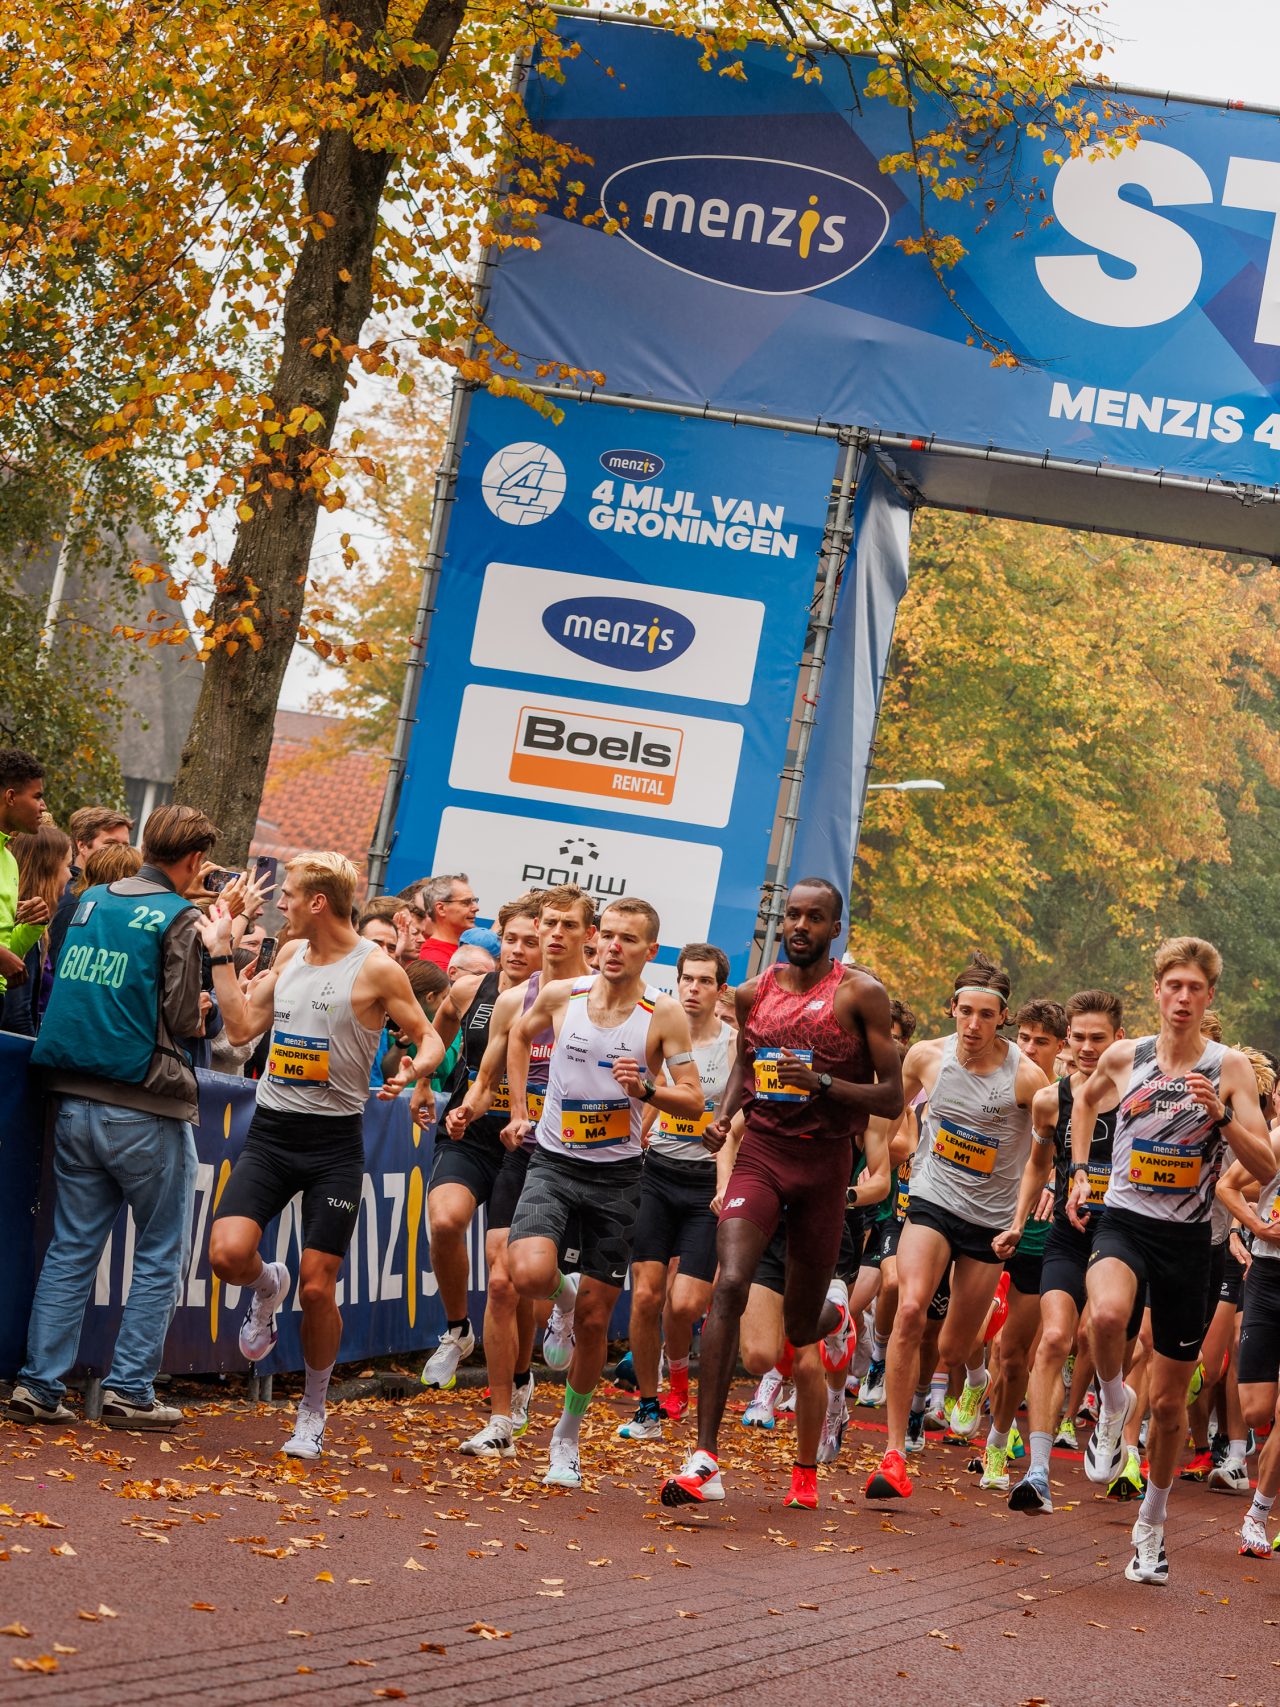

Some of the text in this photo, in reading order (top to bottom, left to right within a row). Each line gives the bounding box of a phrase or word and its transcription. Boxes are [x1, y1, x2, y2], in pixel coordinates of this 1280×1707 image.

[644, 190, 847, 259] menzis
[1048, 382, 1244, 445] MENZIS
[608, 456, 656, 475] menzis
[591, 480, 785, 530] 4 MIJL VAN
[588, 508, 798, 559] GRONINGEN
[563, 612, 675, 653] menzis
[522, 716, 672, 769] Boels
[612, 773, 666, 797] RENTAL
[522, 864, 626, 896] POUW
[128, 905, 166, 932] 22
[59, 944, 129, 989] GOLAZO
[284, 1038, 308, 1047] menzis
[275, 1048, 320, 1061] HENDRIKSE
[284, 1064, 304, 1076] M6
[1142, 1080, 1193, 1091] sauco
[491, 1099, 509, 1108] 28
[581, 1103, 608, 1111] menzis
[579, 1114, 612, 1124] DELY
[585, 1127, 607, 1139] M4
[676, 1124, 694, 1133] W8
[946, 1135, 987, 1155] LEMMINK
[1153, 1146, 1180, 1155] menzis
[954, 1151, 970, 1163] M1
[1139, 1156, 1193, 1168] VANOPPEN
[1154, 1172, 1175, 1183] M2
